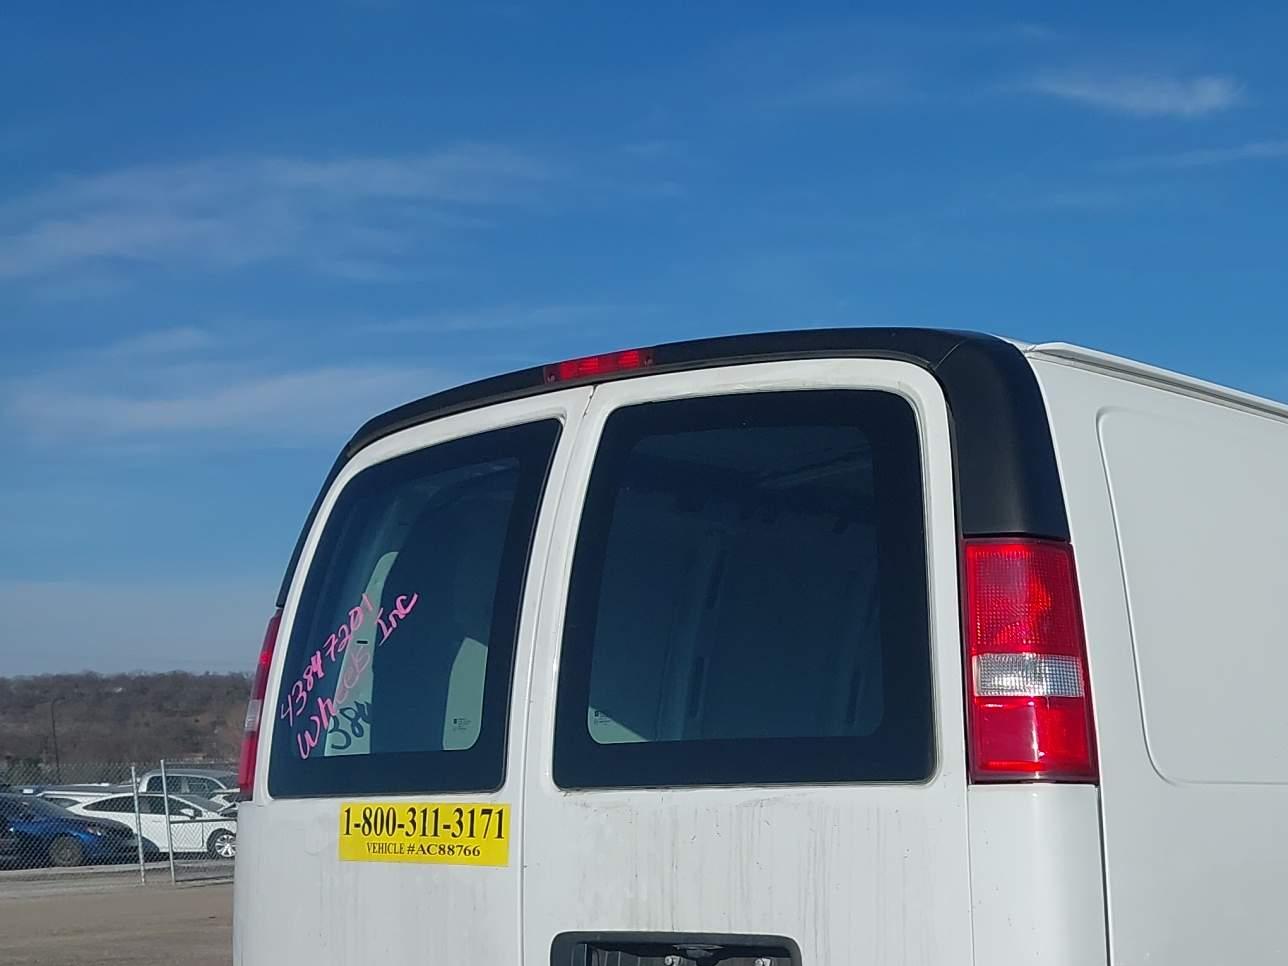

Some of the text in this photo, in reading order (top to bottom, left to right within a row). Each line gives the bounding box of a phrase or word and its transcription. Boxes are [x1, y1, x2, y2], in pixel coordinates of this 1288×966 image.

[374, 592, 419, 647] Inc
[280, 592, 374, 728] 43847201
[343, 806, 505, 840] 1-800-311-3171
[366, 842, 481, 857] VEHICLE #AC88766
